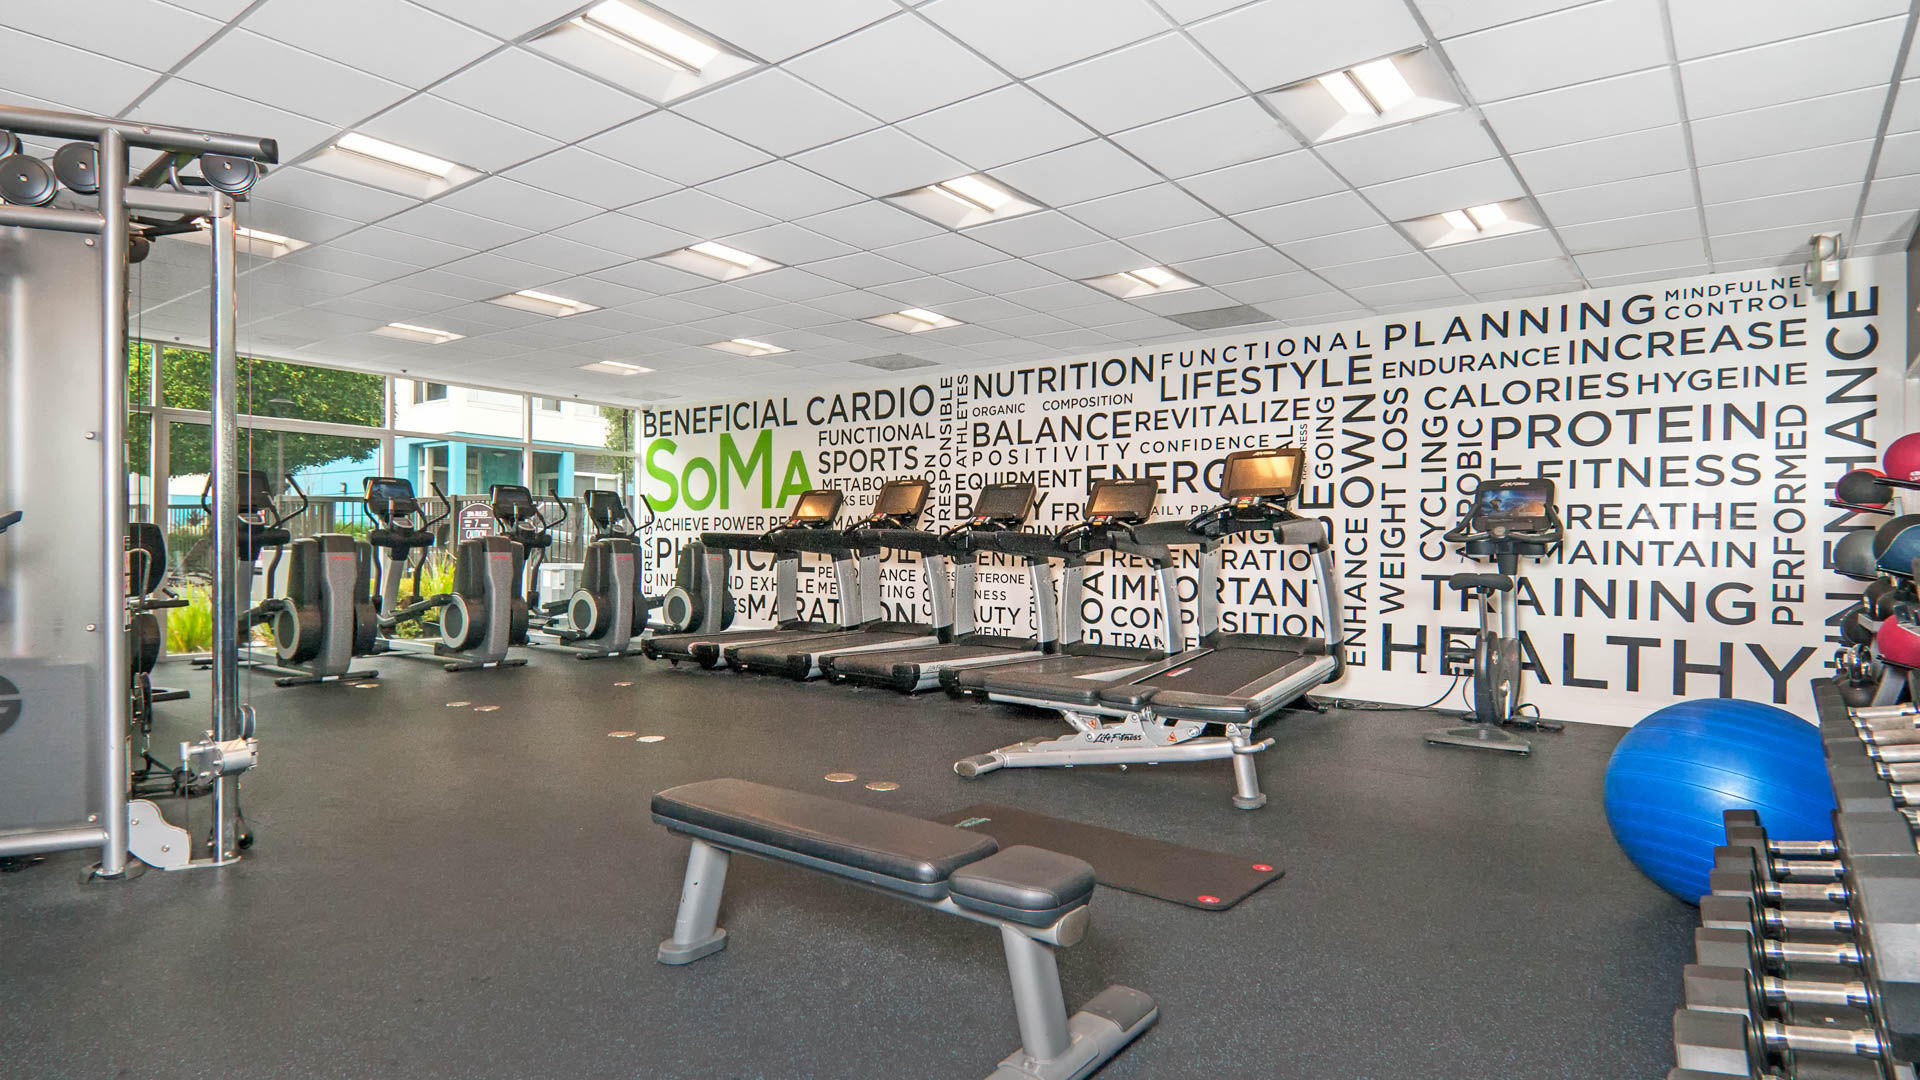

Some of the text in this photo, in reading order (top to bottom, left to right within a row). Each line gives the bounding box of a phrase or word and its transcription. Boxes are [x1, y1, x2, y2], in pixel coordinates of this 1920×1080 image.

[1664, 293, 1808, 320] CONTROL
[1665, 275, 1813, 302] MINDFULNE
[1384, 294, 1656, 350] PLANNING
[1568, 318, 1808, 366] INCREASE
[1161, 330, 1371, 370] FUNCTIONAL
[1382, 346, 1560, 379] ENDURANCE
[973, 354, 1154, 400] NUTRITION
[1160, 353, 1373, 402] LIFESTYLE
[1424, 372, 1629, 410] CALORIES
[1637, 362, 1808, 395] HYGEINE
[643, 384, 935, 438] BENEFICIAL CARDIO
[956, 374, 969, 468] ATHLETES
[972, 403, 1026, 418] ORGANIC
[1042, 393, 1133, 412] COMPOSITION
[1135, 397, 1311, 432] REVITALIZE
[818, 422, 936, 447] FUNCTIONAL
[973, 410, 1132, 448] BALANCE
[1140, 434, 1270, 454] CONFIDENCE
[1315, 396, 1336, 479] GOING
[1490, 401, 1766, 450] PROTEIN
[1823, 285, 1879, 570] NHANCE
[818, 445, 919, 474] SPORTS
[939, 376, 953, 521] RESPONSIBLE
[972, 442, 1131, 467] POSITIVITY
[1340, 394, 1377, 508] OWN
[1419, 416, 1449, 561] CYCLING
[1537, 453, 1761, 489] FITNESS
[1151, 505, 1183, 516] AILY
[1379, 387, 1409, 615] WEIGHT LOSS
[1553, 502, 1758, 531] REATHE
[1771, 404, 1808, 626] PERFORMED
[655, 517, 709, 531] ACHIEVE
[714, 516, 765, 531] POWER
[643, 515, 653, 595] ECREASE
[1344, 516, 1369, 668] ENHANCE
[1381, 622, 1819, 705] HEALTHY
